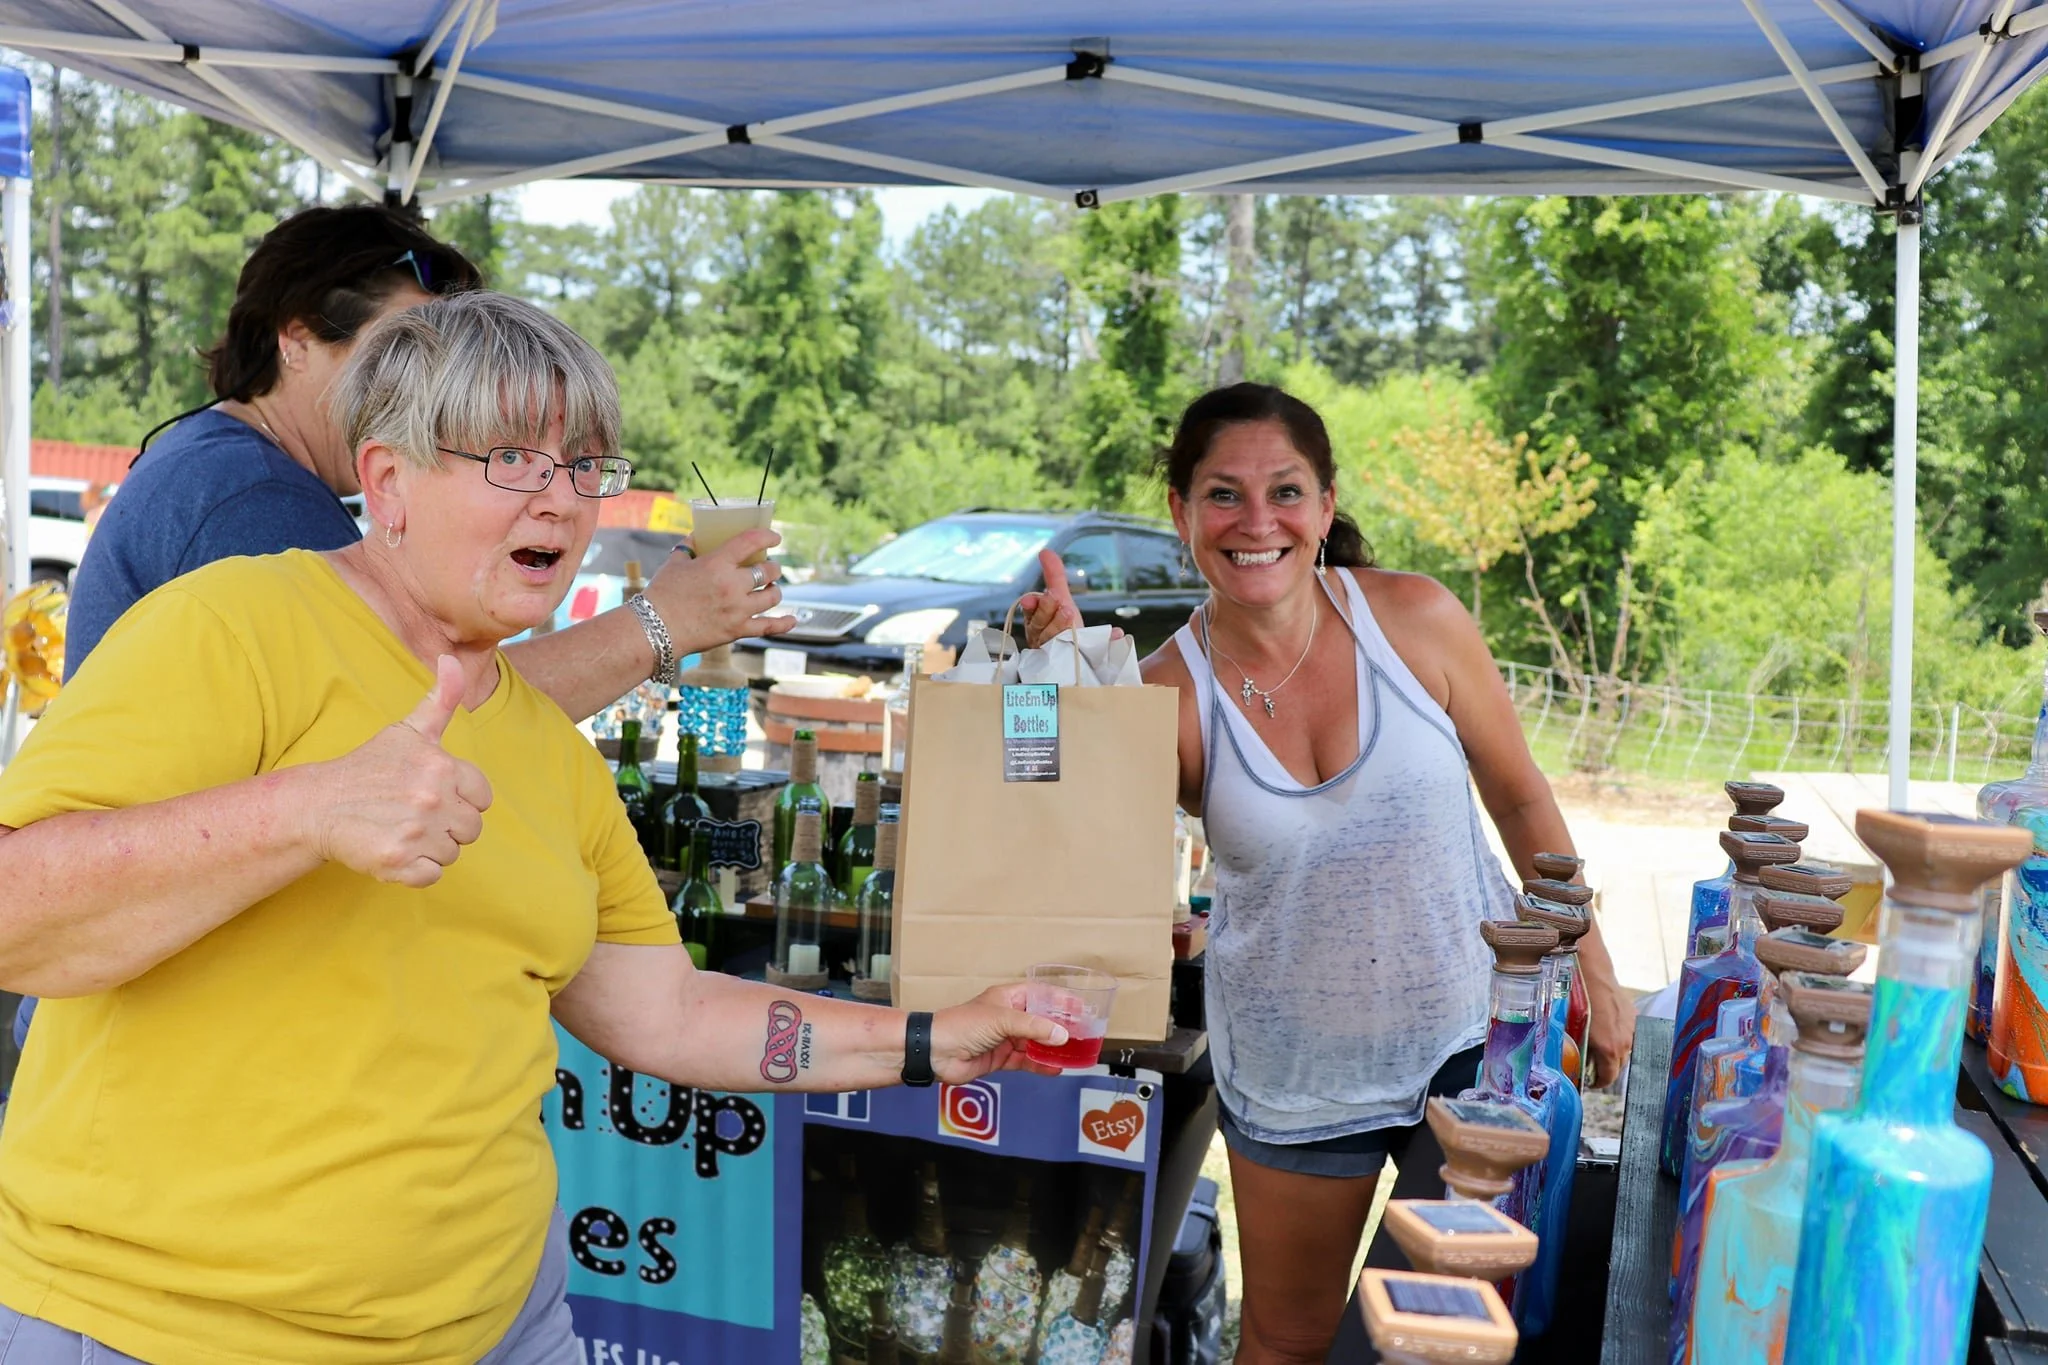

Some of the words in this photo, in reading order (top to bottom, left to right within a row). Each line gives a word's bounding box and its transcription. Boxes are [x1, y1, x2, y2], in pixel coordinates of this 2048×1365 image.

[1013, 714, 1049, 733] Bottles
[609, 1062, 767, 1179] Up
[1090, 1115, 1137, 1142] Etsy
